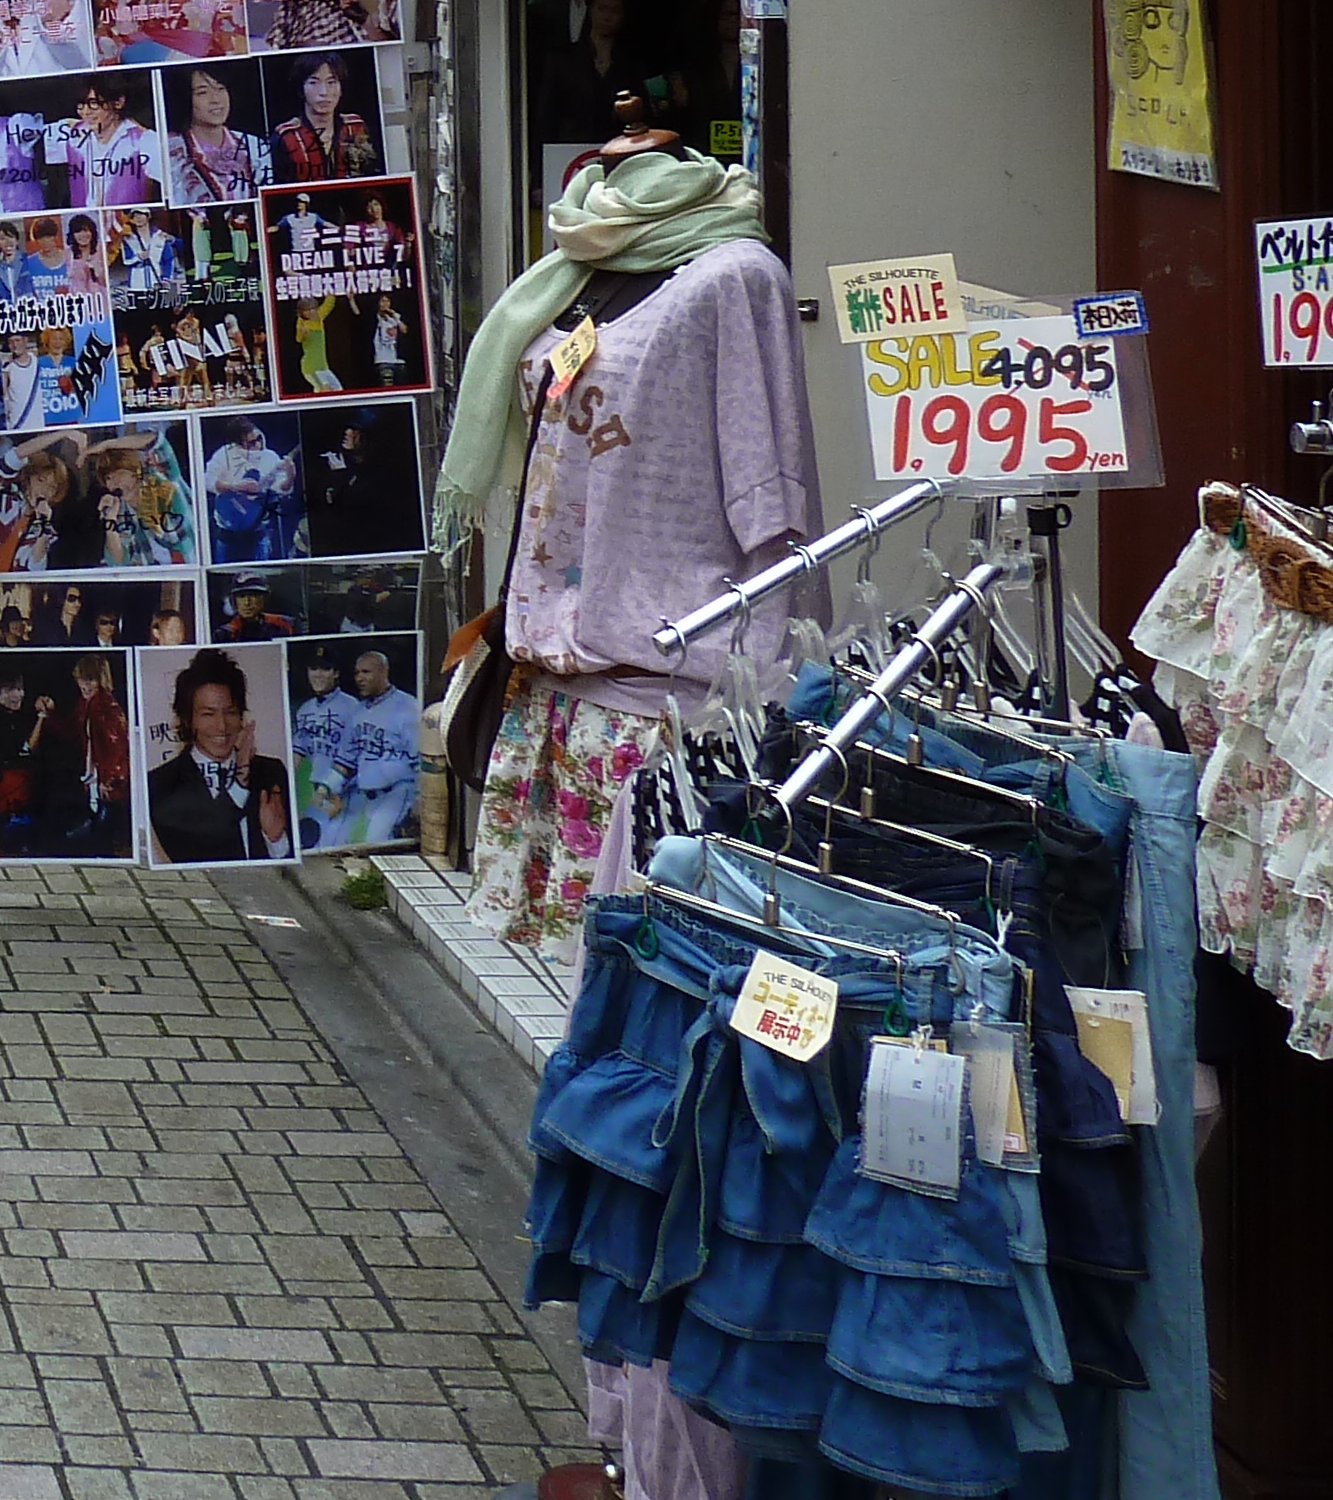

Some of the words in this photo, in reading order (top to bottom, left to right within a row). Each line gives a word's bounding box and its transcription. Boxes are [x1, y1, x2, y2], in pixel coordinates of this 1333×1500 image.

[91, 154, 150, 180] JUMP
[281, 250, 334, 272] DREAM
[343, 246, 386, 267] LIVE
[843, 275, 866, 289] THE
[868, 267, 939, 282] SILHOUETTE
[883, 280, 949, 325] SALE
[1083, 300, 1139, 331] 本日入荷
[150, 323, 241, 376] FINAL
[867, 331, 1002, 397] SALE
[1087, 451, 1126, 472] yen
[763, 971, 789, 986] THE
[756, 1008, 801, 1047] 展示中
